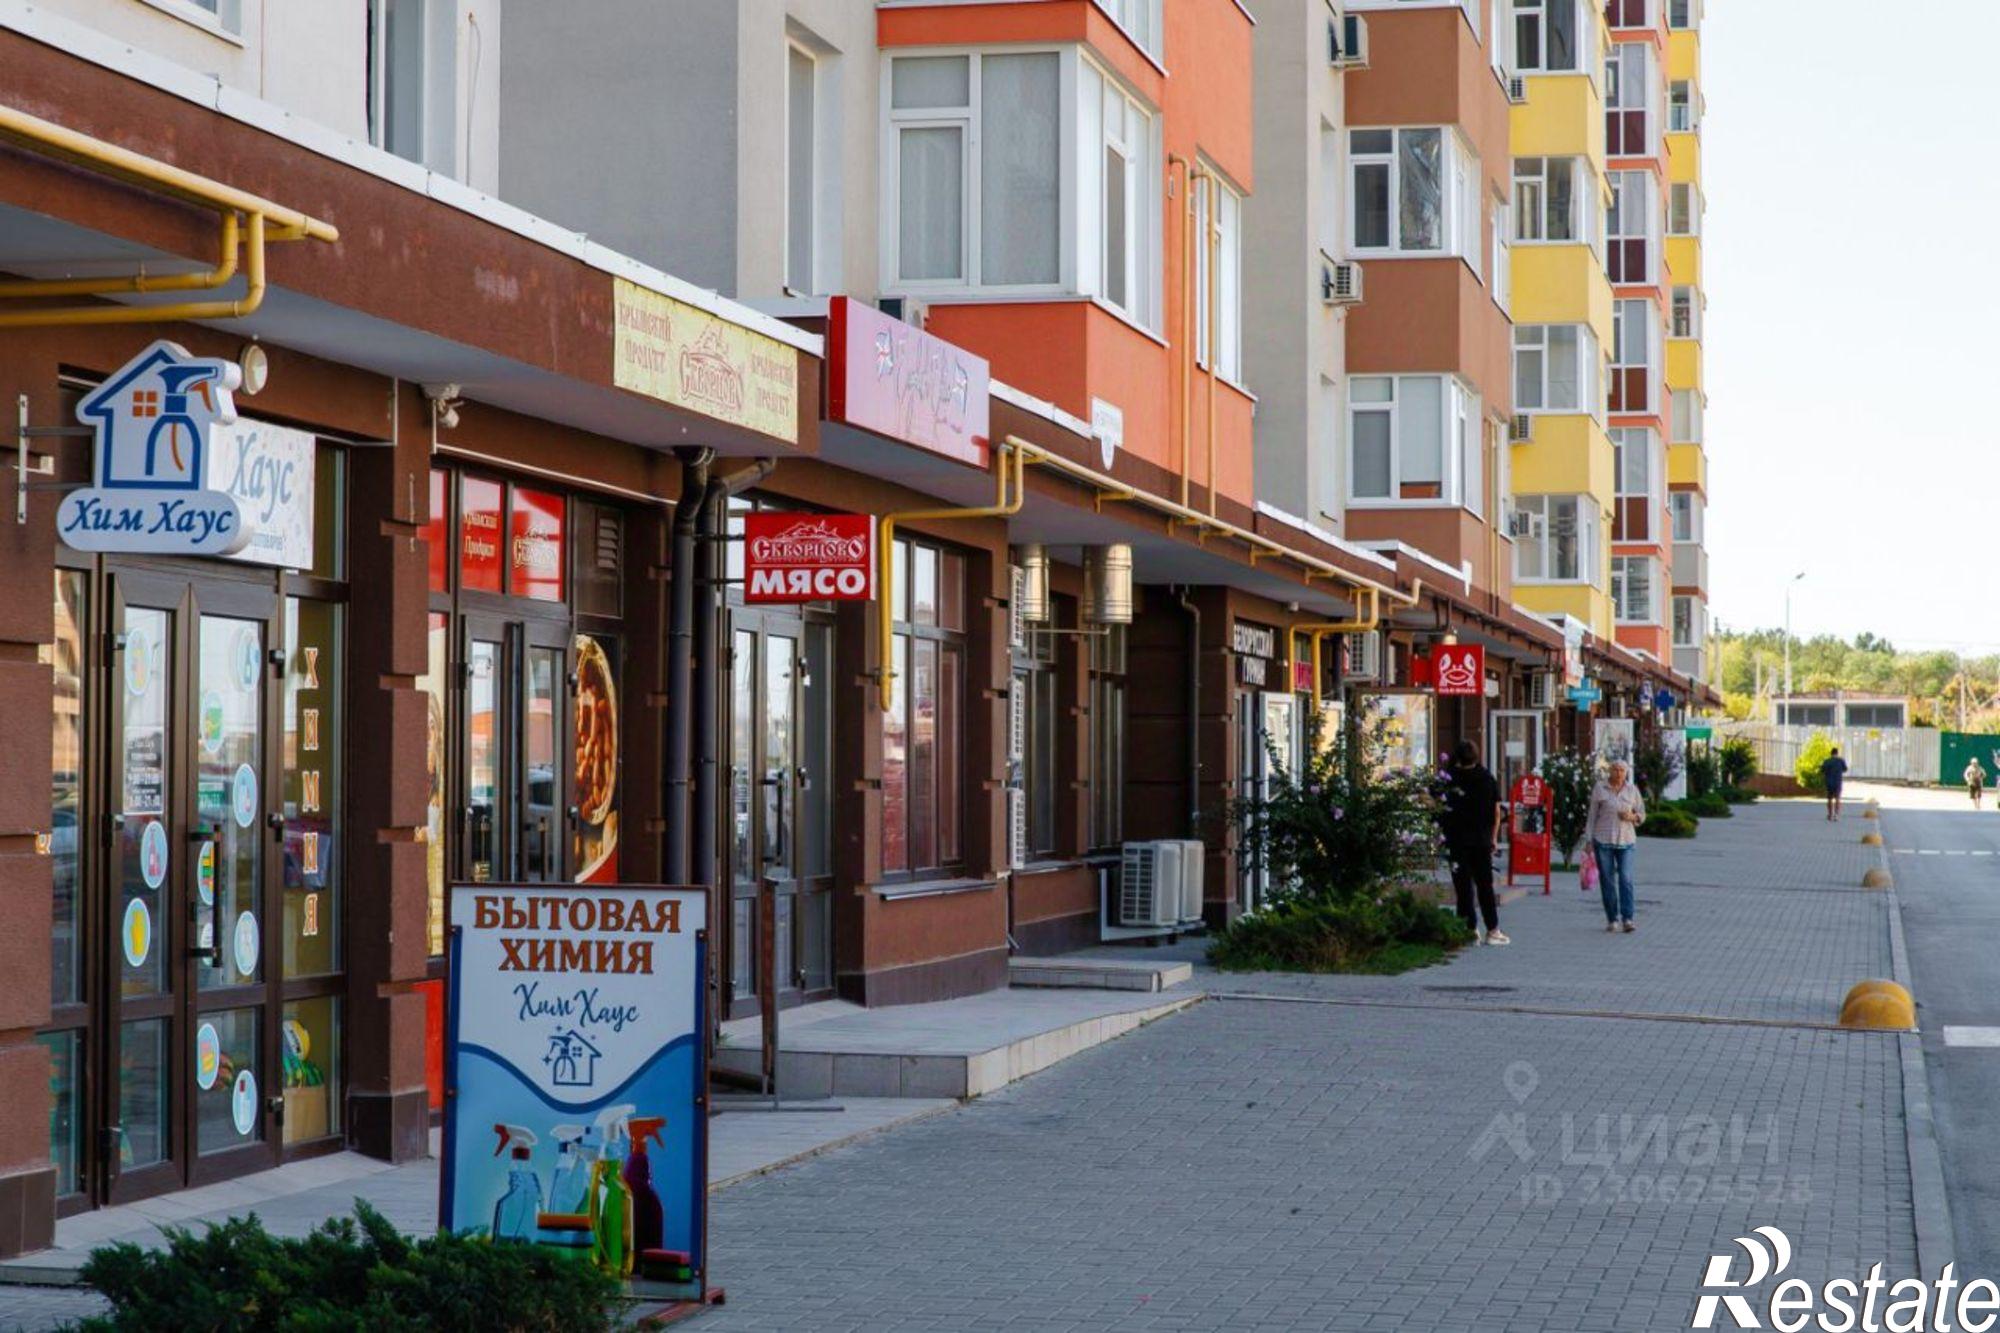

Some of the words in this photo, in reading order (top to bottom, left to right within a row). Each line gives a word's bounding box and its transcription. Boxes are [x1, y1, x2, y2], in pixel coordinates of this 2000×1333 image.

[228, 432, 294, 523] Хаус
[64, 497, 143, 531] Хим
[148, 499, 233, 543] Хаус
[750, 568, 866, 595] МЯСО
[302, 647, 320, 936] ХИМИЯ
[473, 895, 682, 934] БЫТОВАЯ
[497, 938, 655, 975] ХИМИЯ
[512, 981, 575, 1022] Хим
[574, 987, 640, 1033] Хаус
